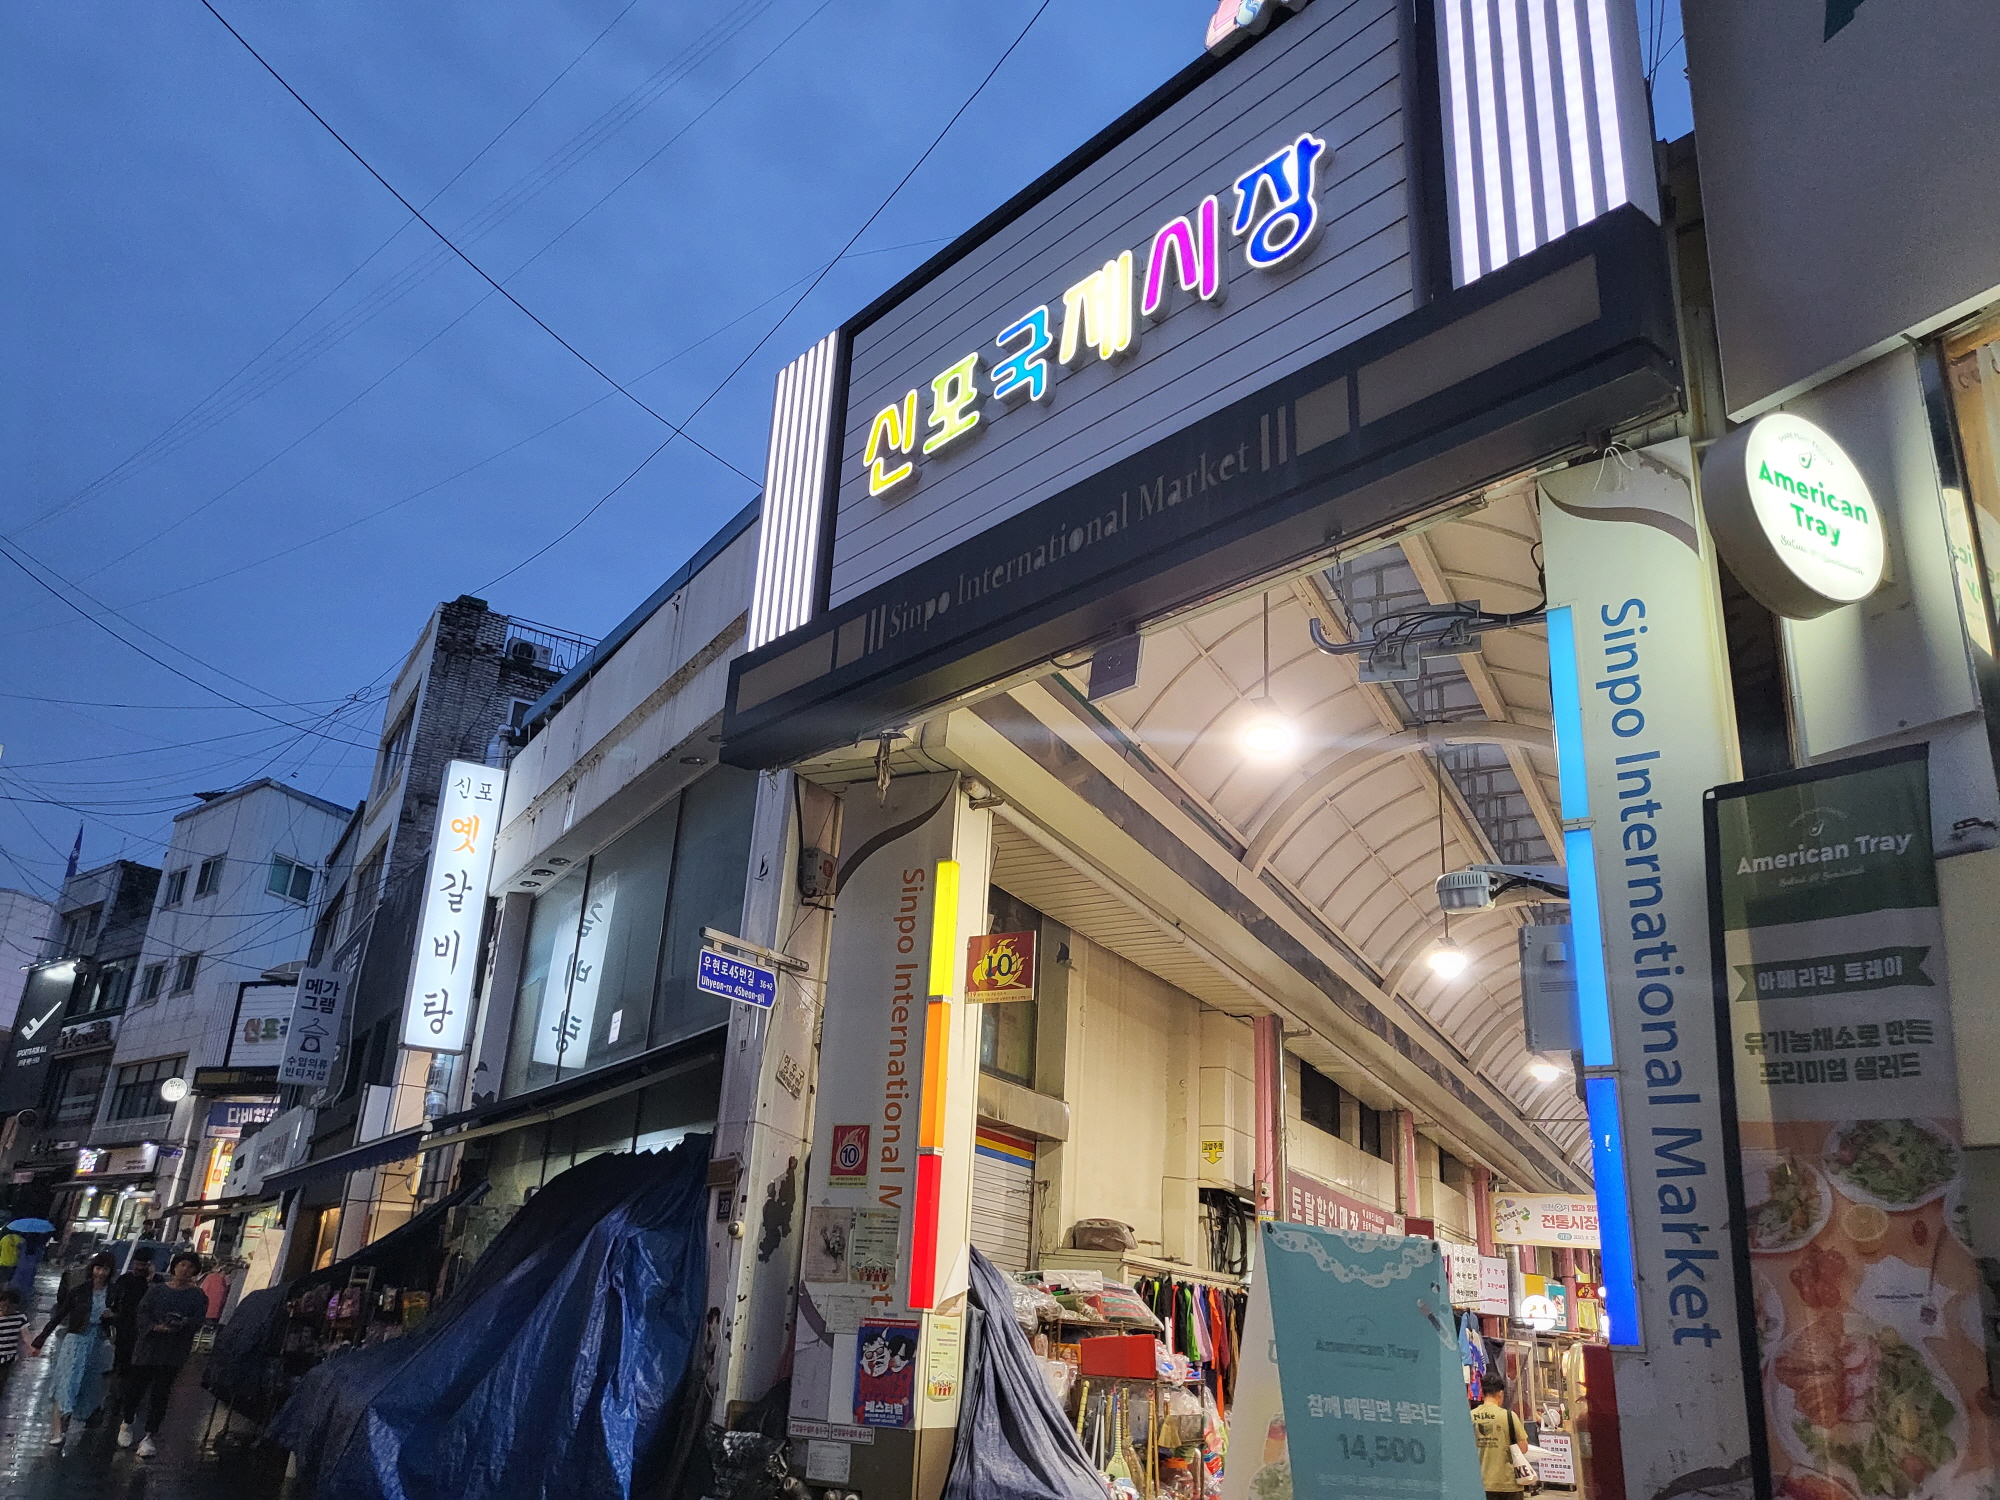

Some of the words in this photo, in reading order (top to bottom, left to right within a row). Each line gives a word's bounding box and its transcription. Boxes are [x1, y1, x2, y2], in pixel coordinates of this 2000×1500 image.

[863, 132, 1326, 497] 신포국제시장
[1759, 460, 1868, 525] American
[889, 590, 950, 638] Sinpo
[957, 492, 1129, 605] International
[1138, 441, 1250, 523] Market
[1790, 503, 1841, 546] Tray
[1597, 598, 1645, 738] Sinpo
[454, 777, 493, 801] 신포
[1737, 843, 1850, 876] American
[1854, 832, 1913, 855] Tray
[893, 868, 925, 954] Sinpo
[1615, 750, 1701, 1105] International
[703, 956, 755, 986] 우현로45번길
[985, 953, 1013, 978] 10
[1758, 964, 1836, 991] 아메리칸
[1844, 955, 1904, 982] 트레이
[305, 978, 340, 997] 메가
[701, 975, 733, 993] Uhyeon-ro
[734, 985, 765, 1003] 45beon-gil
[301, 996, 336, 1014] 그램
[1744, 1023, 1881, 1055] 유기농채소로
[1885, 1019, 1933, 1046] 만든
[285, 1067, 326, 1081] 빈티지샵
[287, 1056, 328, 1069] 수입의류
[880, 963, 918, 1173] International
[1759, 1057, 1850, 1085] 프리미엄
[1854, 1052, 1922, 1081] 샐러드
[843, 1148, 857, 1163] 10
[1541, 1214, 1598, 1230] 전통시장
[1652, 1127, 1722, 1348] Market
[865, 1400, 904, 1416] 페스티벌
[1307, 1393, 1341, 1419] 참깨
[1343, 1397, 1392, 1422] 메밀면
[1395, 1401, 1445, 1425] 샐러드
[1473, 1412, 1496, 1421] Nike
[1338, 1433, 1426, 1468] 14,500
